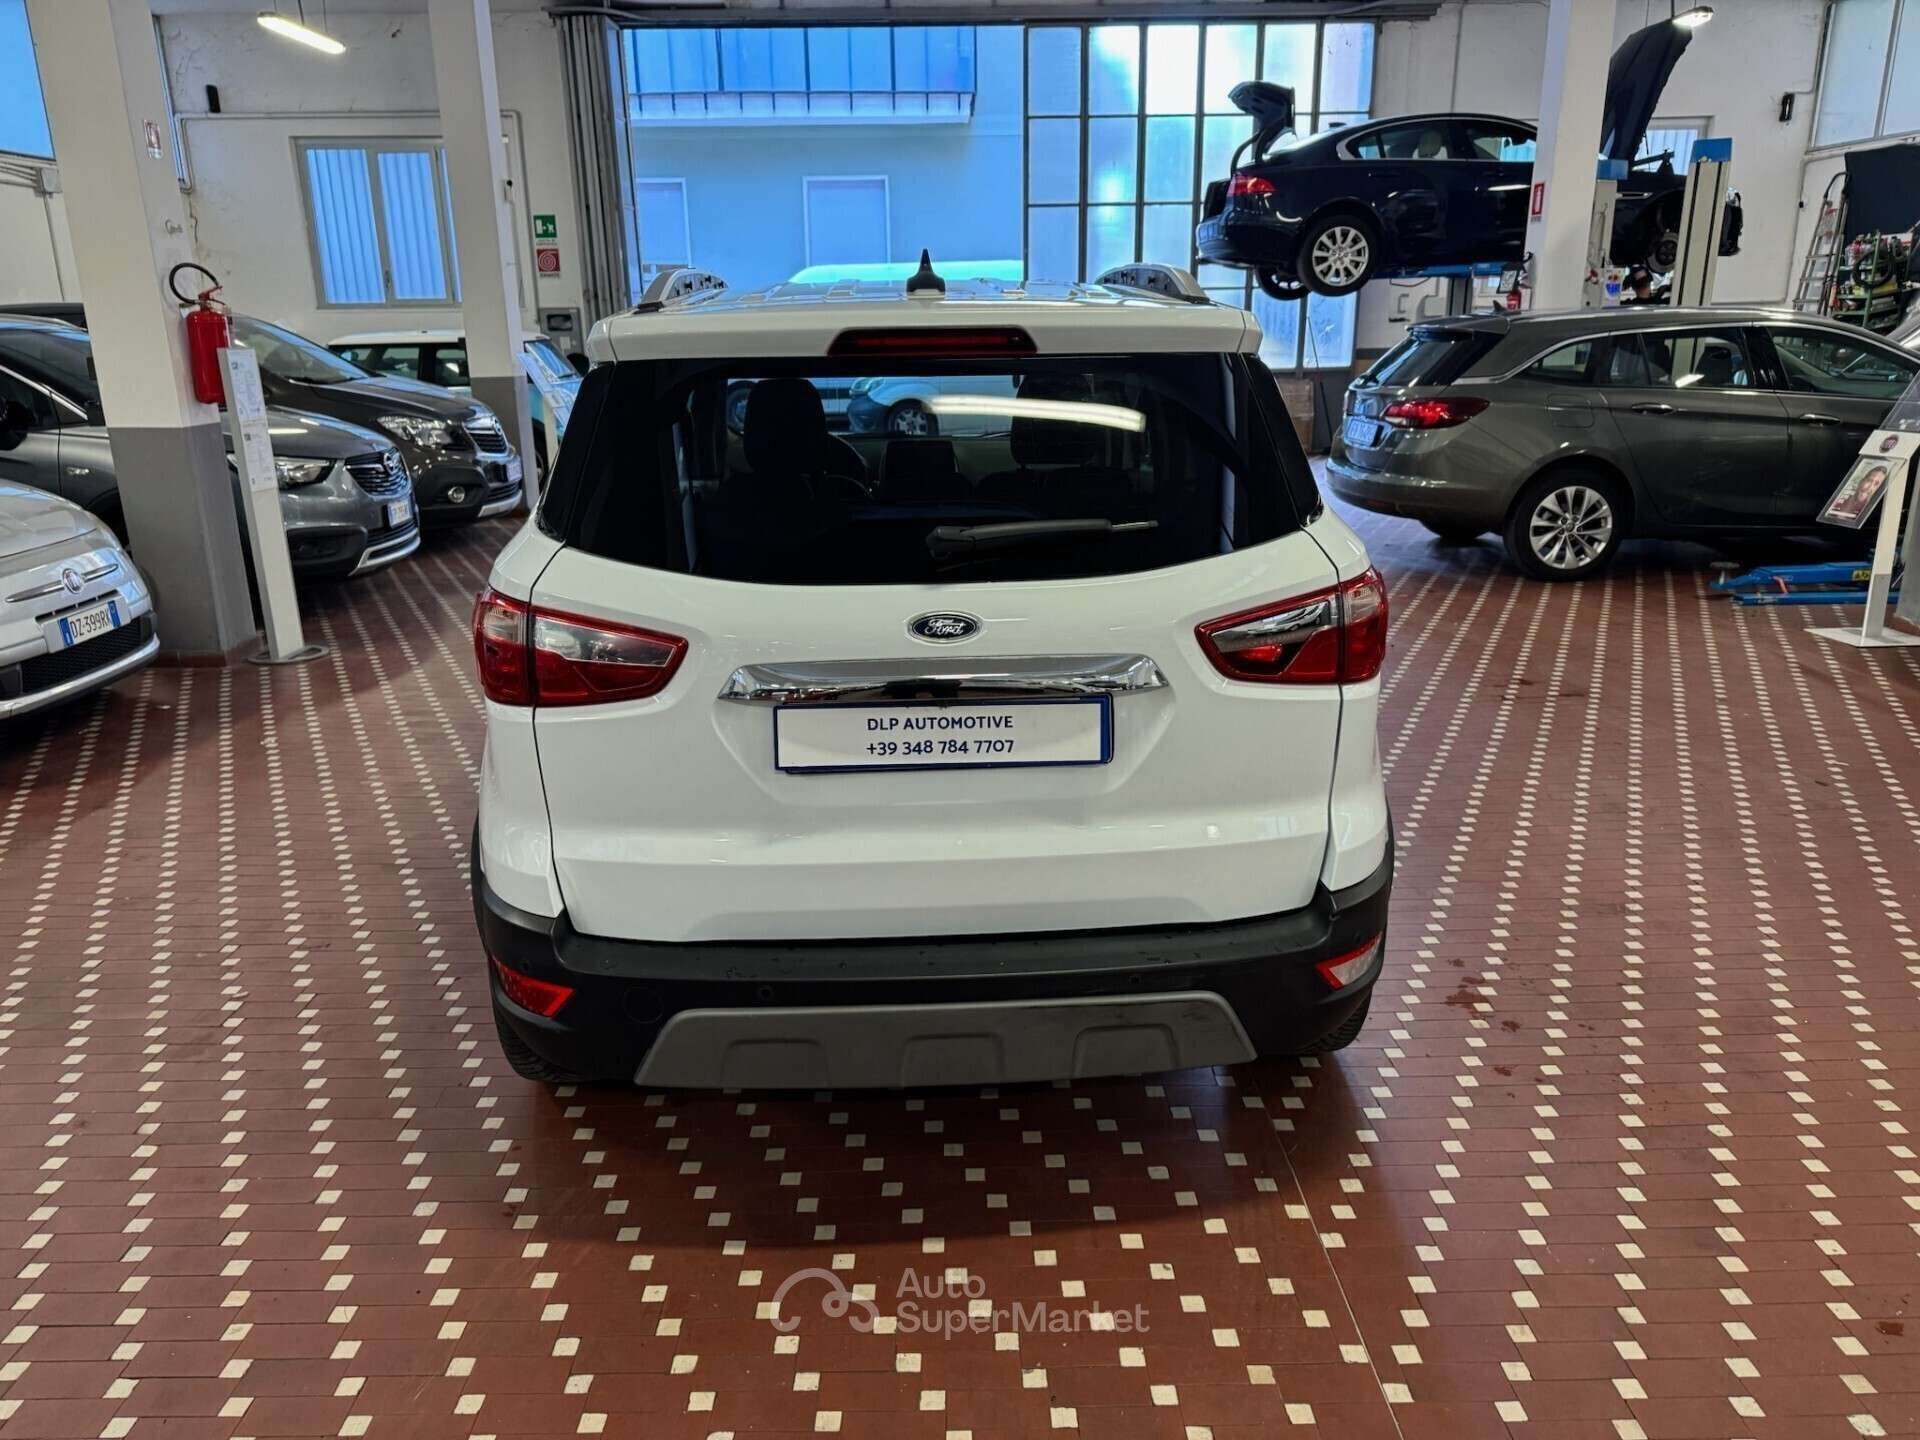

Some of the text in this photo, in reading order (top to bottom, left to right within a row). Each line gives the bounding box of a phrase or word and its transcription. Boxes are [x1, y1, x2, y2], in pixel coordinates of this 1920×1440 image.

[924, 617, 967, 636] Ford
[867, 715, 1014, 731] DLP AUTOMOTIVE
[866, 739, 1014, 756] +39 348 784 7707
